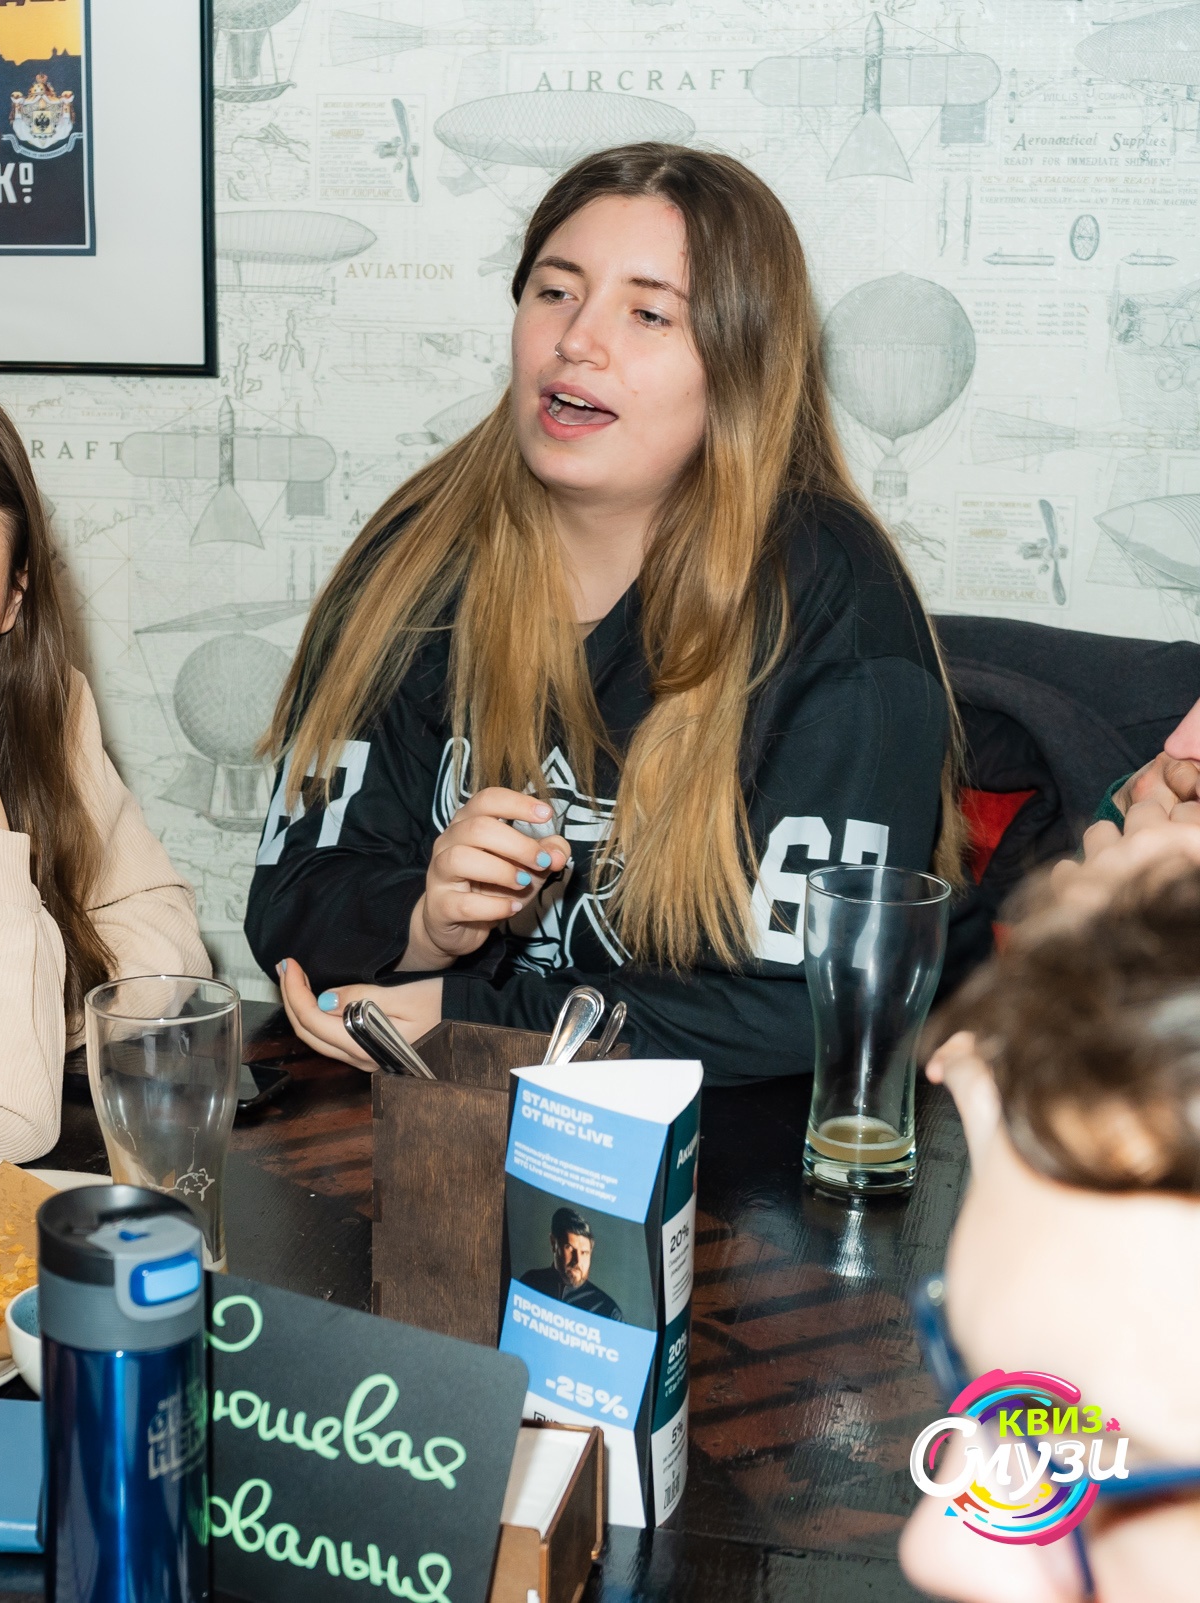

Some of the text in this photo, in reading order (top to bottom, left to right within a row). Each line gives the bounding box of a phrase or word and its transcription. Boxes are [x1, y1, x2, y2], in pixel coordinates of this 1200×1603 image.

[536, 68, 754, 92] AIRCRAFT
[1013, 132, 1099, 151] Aeronautical
[344, 262, 455, 281] AVIATION
[31, 440, 123, 461] RAFT
[521, 1104, 542, 1122] ОТ
[577, 1126, 614, 1149] LIVE
[522, 1089, 594, 1125] STANDUP
[513, 1294, 601, 1343] ПРОМОКОД
[545, 1375, 629, 1420] -25%
[212, 1373, 467, 1490] юшевая
[208, 1478, 453, 1603] овальня
